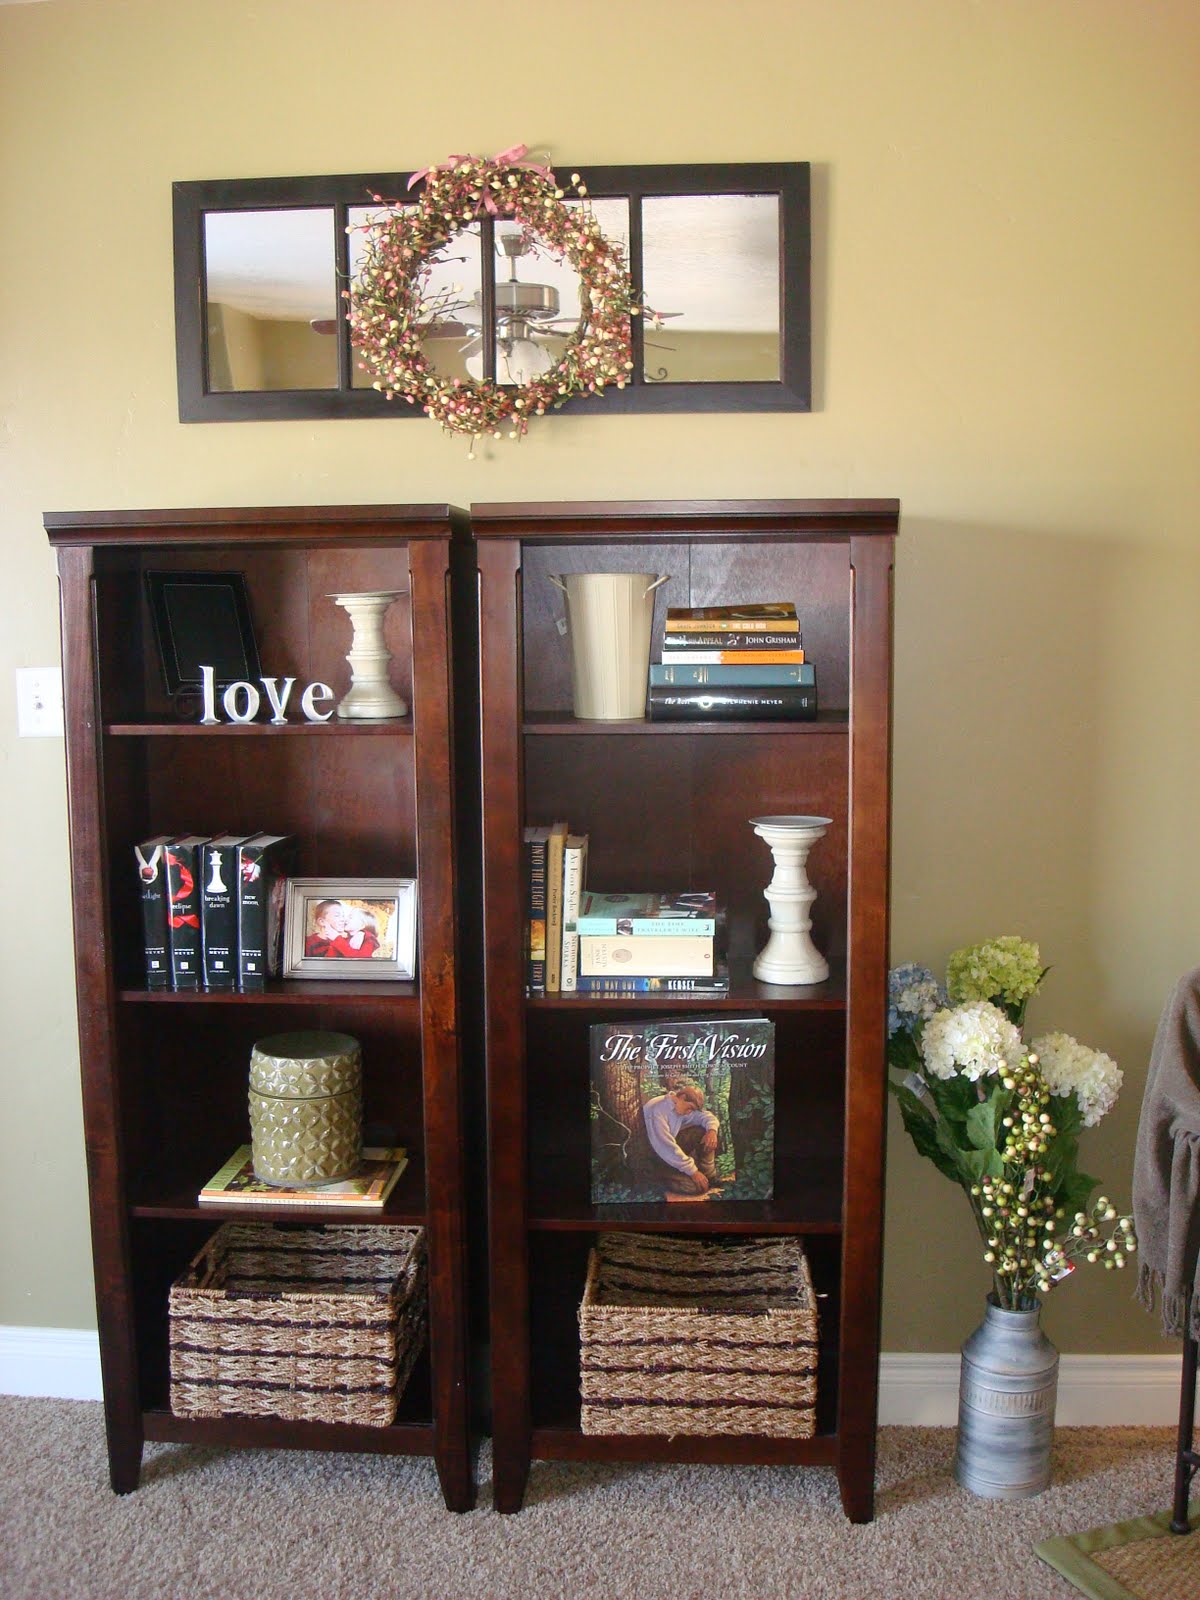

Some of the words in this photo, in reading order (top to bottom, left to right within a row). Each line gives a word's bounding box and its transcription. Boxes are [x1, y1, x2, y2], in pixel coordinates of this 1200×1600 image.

[745, 636, 764, 645] JOHN
[765, 635, 797, 645] GRISHAM
[199, 665, 335, 724] love
[531, 845, 545, 865] INTO
[531, 868, 545, 883] THE
[204, 895, 231, 904] breaking
[531, 886, 545, 911] LIGHT
[567, 889, 578, 911] Sight
[591, 980, 601, 991] NO
[604, 980, 619, 991] WAY
[600, 1034, 643, 1062] The
[645, 1033, 702, 1062] First
[702, 1033, 768, 1061] Vision
